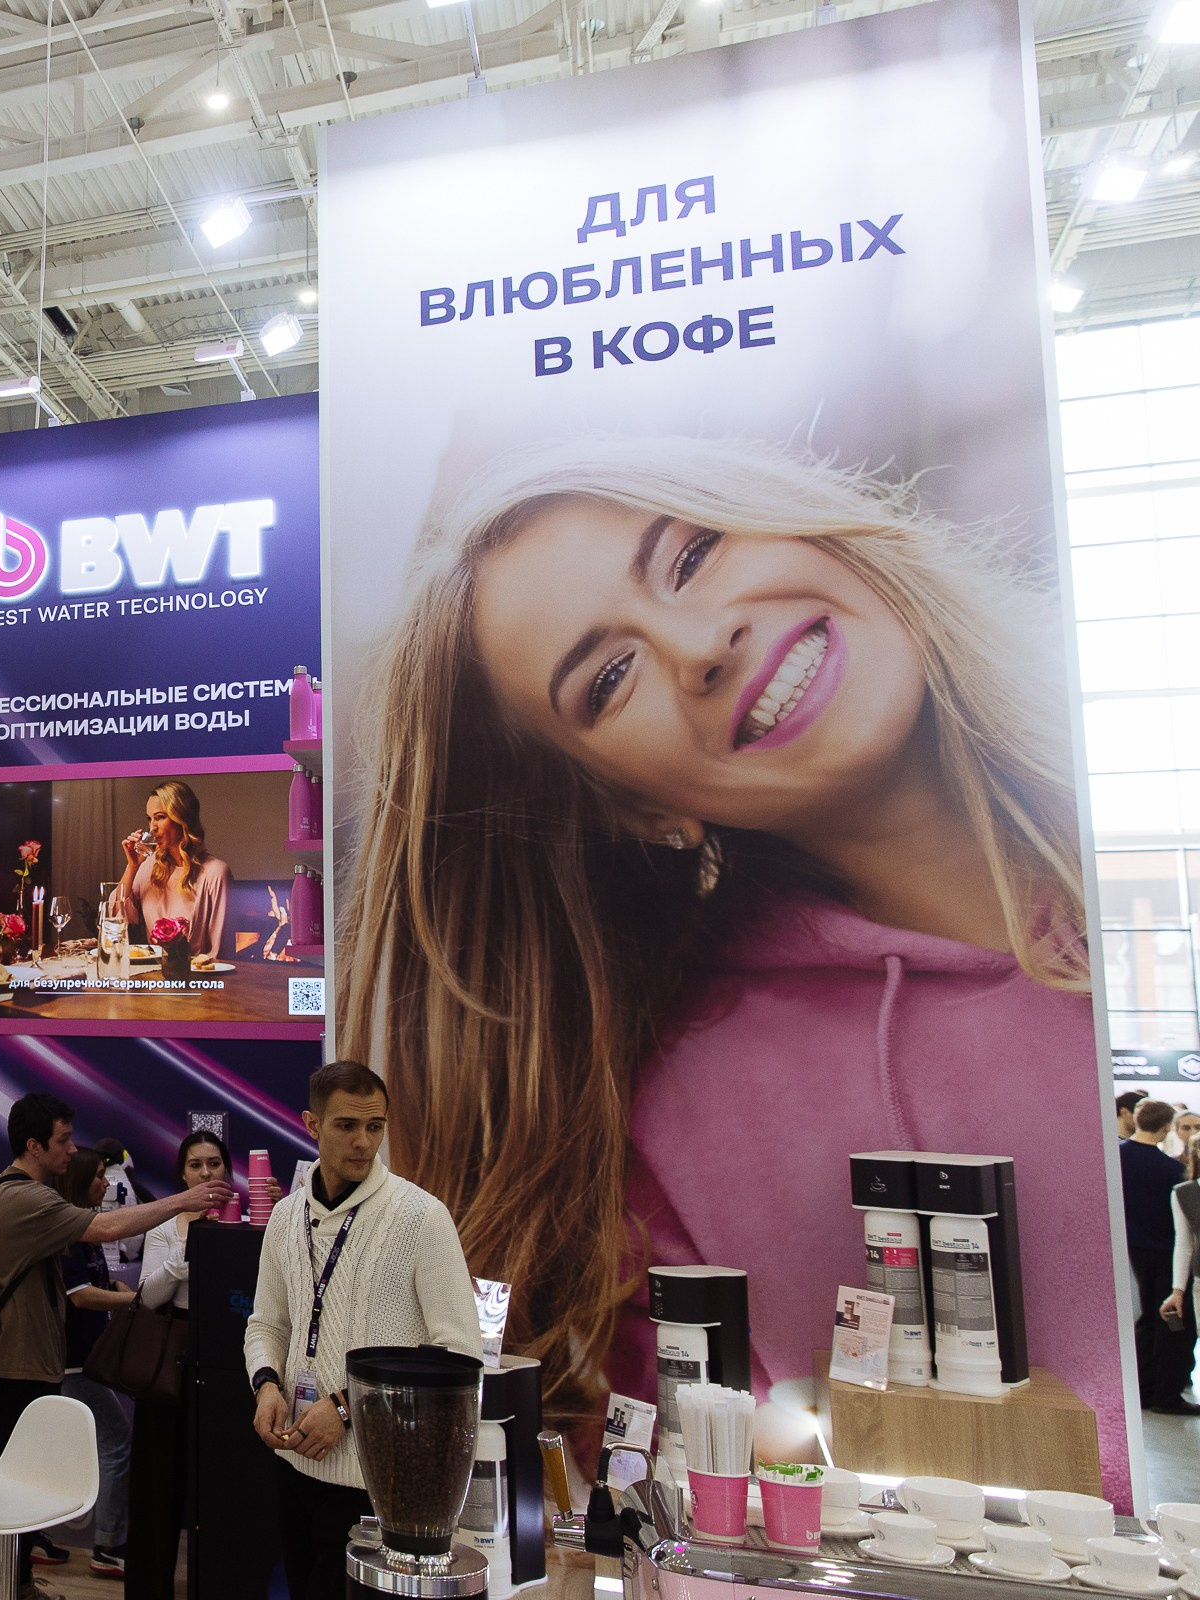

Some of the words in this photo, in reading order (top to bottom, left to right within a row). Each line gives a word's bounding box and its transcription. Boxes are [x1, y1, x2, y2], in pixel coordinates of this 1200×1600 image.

[577, 175, 716, 243] ДЛЯ
[420, 214, 906, 326] ВЛЮБЛЕННЫХ
[534, 336, 573, 377] В
[593, 305, 776, 369] КОФЕ
[61, 499, 274, 592] BWT
[37, 601, 110, 622] WATER
[116, 587, 269, 616] TECHNOLOGY
[193, 678, 318, 702] СИСТЕМ
[175, 709, 250, 731] ВОДЫ
[9, 980, 29, 989] для
[34, 977, 110, 990] безупречной
[113, 979, 185, 991] сервировки
[189, 980, 224, 989] стола
[342, 1215, 353, 1231] BWT
[870, 1250, 879, 1259] 14
[317, 1283, 326, 1298] BWT
[309, 1333, 318, 1349] BWT
